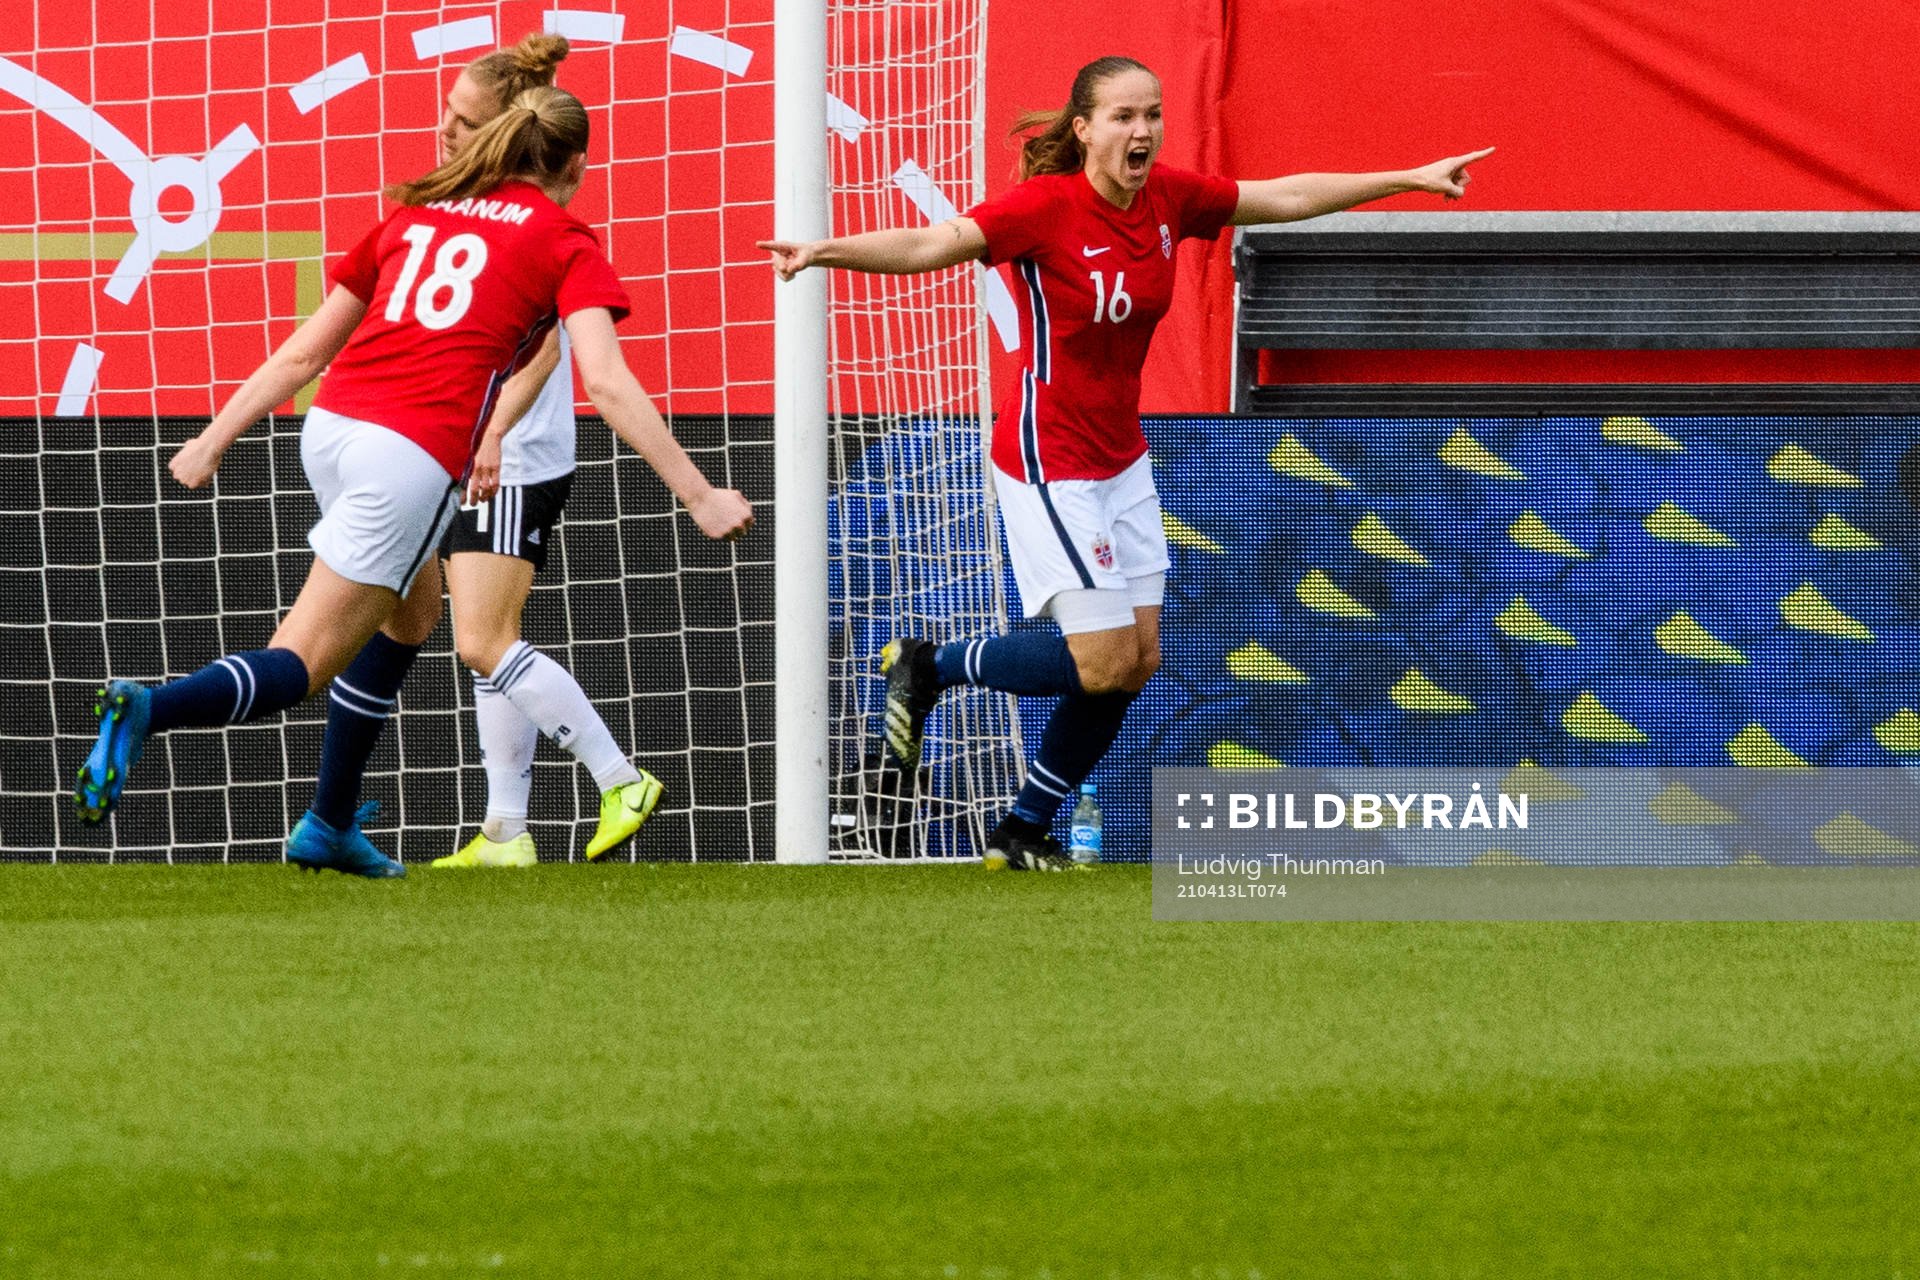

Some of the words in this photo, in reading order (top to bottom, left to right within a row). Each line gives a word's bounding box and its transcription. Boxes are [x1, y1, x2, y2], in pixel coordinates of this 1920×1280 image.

[425, 197, 534, 225] AANUM
[384, 223, 488, 330] 18
[1089, 270, 1132, 323] 16
